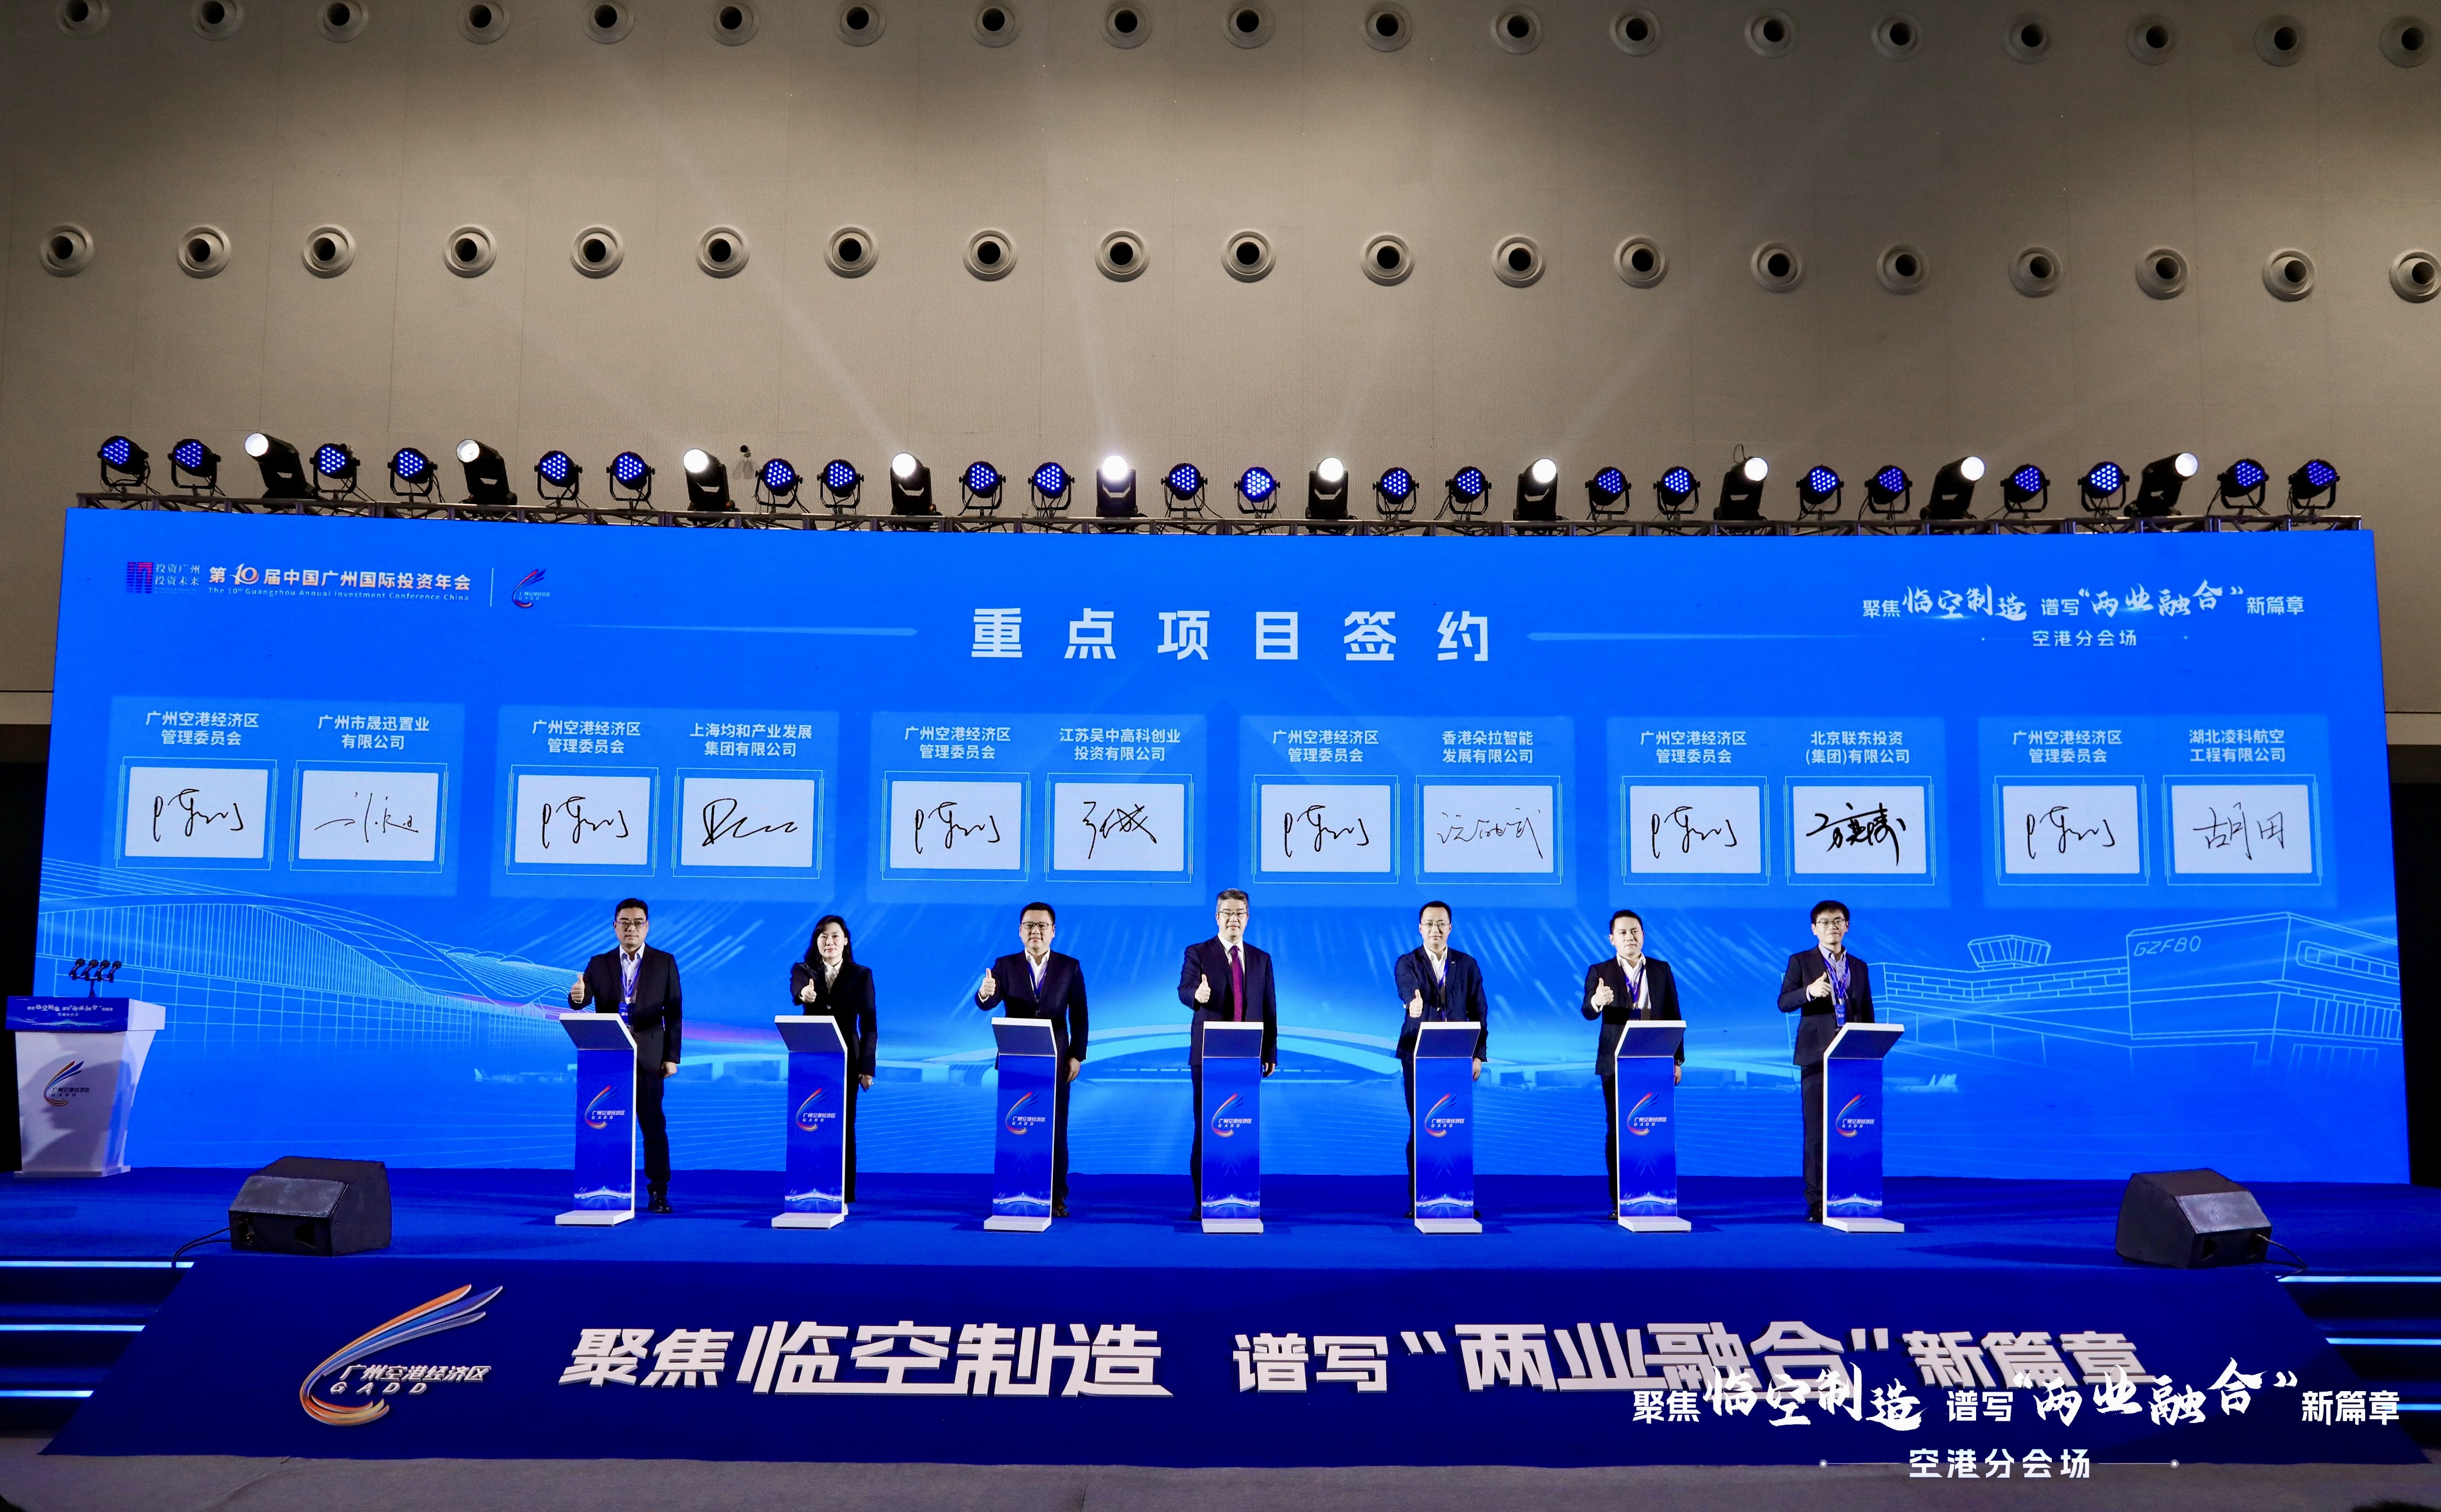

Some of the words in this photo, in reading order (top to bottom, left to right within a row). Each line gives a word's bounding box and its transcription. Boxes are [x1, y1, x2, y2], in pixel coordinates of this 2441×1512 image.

[245, 588, 296, 597] Guangzhou
[970, 607, 1489, 662] 重点项目签约
[2032, 630, 2137, 647] 空港分会场
[146, 711, 259, 727] 广州空港经济区
[318, 715, 429, 731] 广州市晟迅置业
[532, 720, 641, 736] 广州空港经济区
[690, 722, 812, 739] 上海均和产业发展
[905, 726, 1011, 741] 广州空港经济区
[1059, 727, 1181, 743] 江苏吴中高科创业
[2189, 729, 2284, 743] 湖北凌科航空
[161, 729, 241, 746] 管理委员会
[341, 733, 404, 750] 有限公司
[1273, 730, 1379, 744] 广州空港经济区
[1442, 730, 1533, 746] 香港朵拉智能
[1640, 731, 1747, 745] 广州空港经济区
[1811, 731, 1902, 746] 北京联东投资
[2013, 730, 2122, 744] 广州空港经济区
[547, 738, 625, 754] 管理委员会
[704, 741, 796, 757] 集团有限公司
[919, 744, 995, 759] 管理委员会
[1074, 746, 1165, 761] 投资有限公司
[1288, 747, 1363, 763] 管理委员会
[1443, 748, 1533, 764] 发展有限公司
[1656, 748, 1732, 763] 管理委员会
[2029, 748, 2106, 763] 管理委员会
[2190, 748, 2285, 762] 工程有限公司
[558, 1320, 1174, 1398] 聚焦临空制造
[339, 1364, 492, 1383] 广州空港经济区
[330, 1381, 428, 1396] GADD
